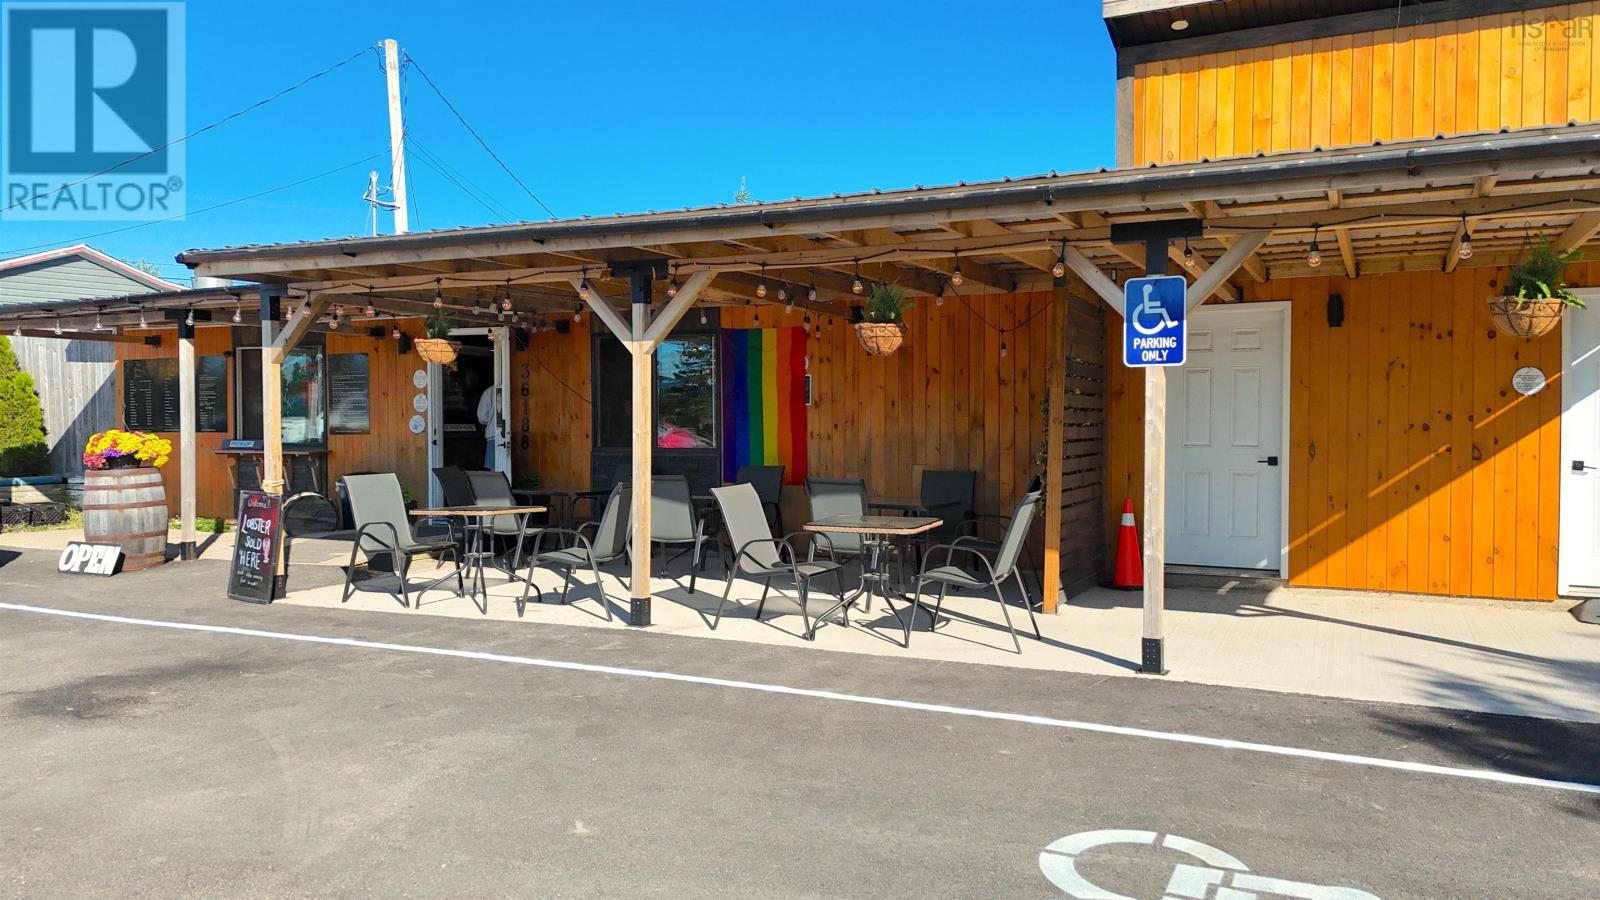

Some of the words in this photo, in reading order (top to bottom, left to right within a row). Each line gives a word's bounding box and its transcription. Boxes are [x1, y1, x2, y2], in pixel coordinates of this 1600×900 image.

[1133, 337, 1177, 349] PARKING
[1141, 350, 1169, 362] ONLY
[241, 514, 271, 536] LOBSTER
[244, 535, 262, 550] SOLD
[58, 543, 122, 575] OPEN
[239, 550, 261, 570] HERE
